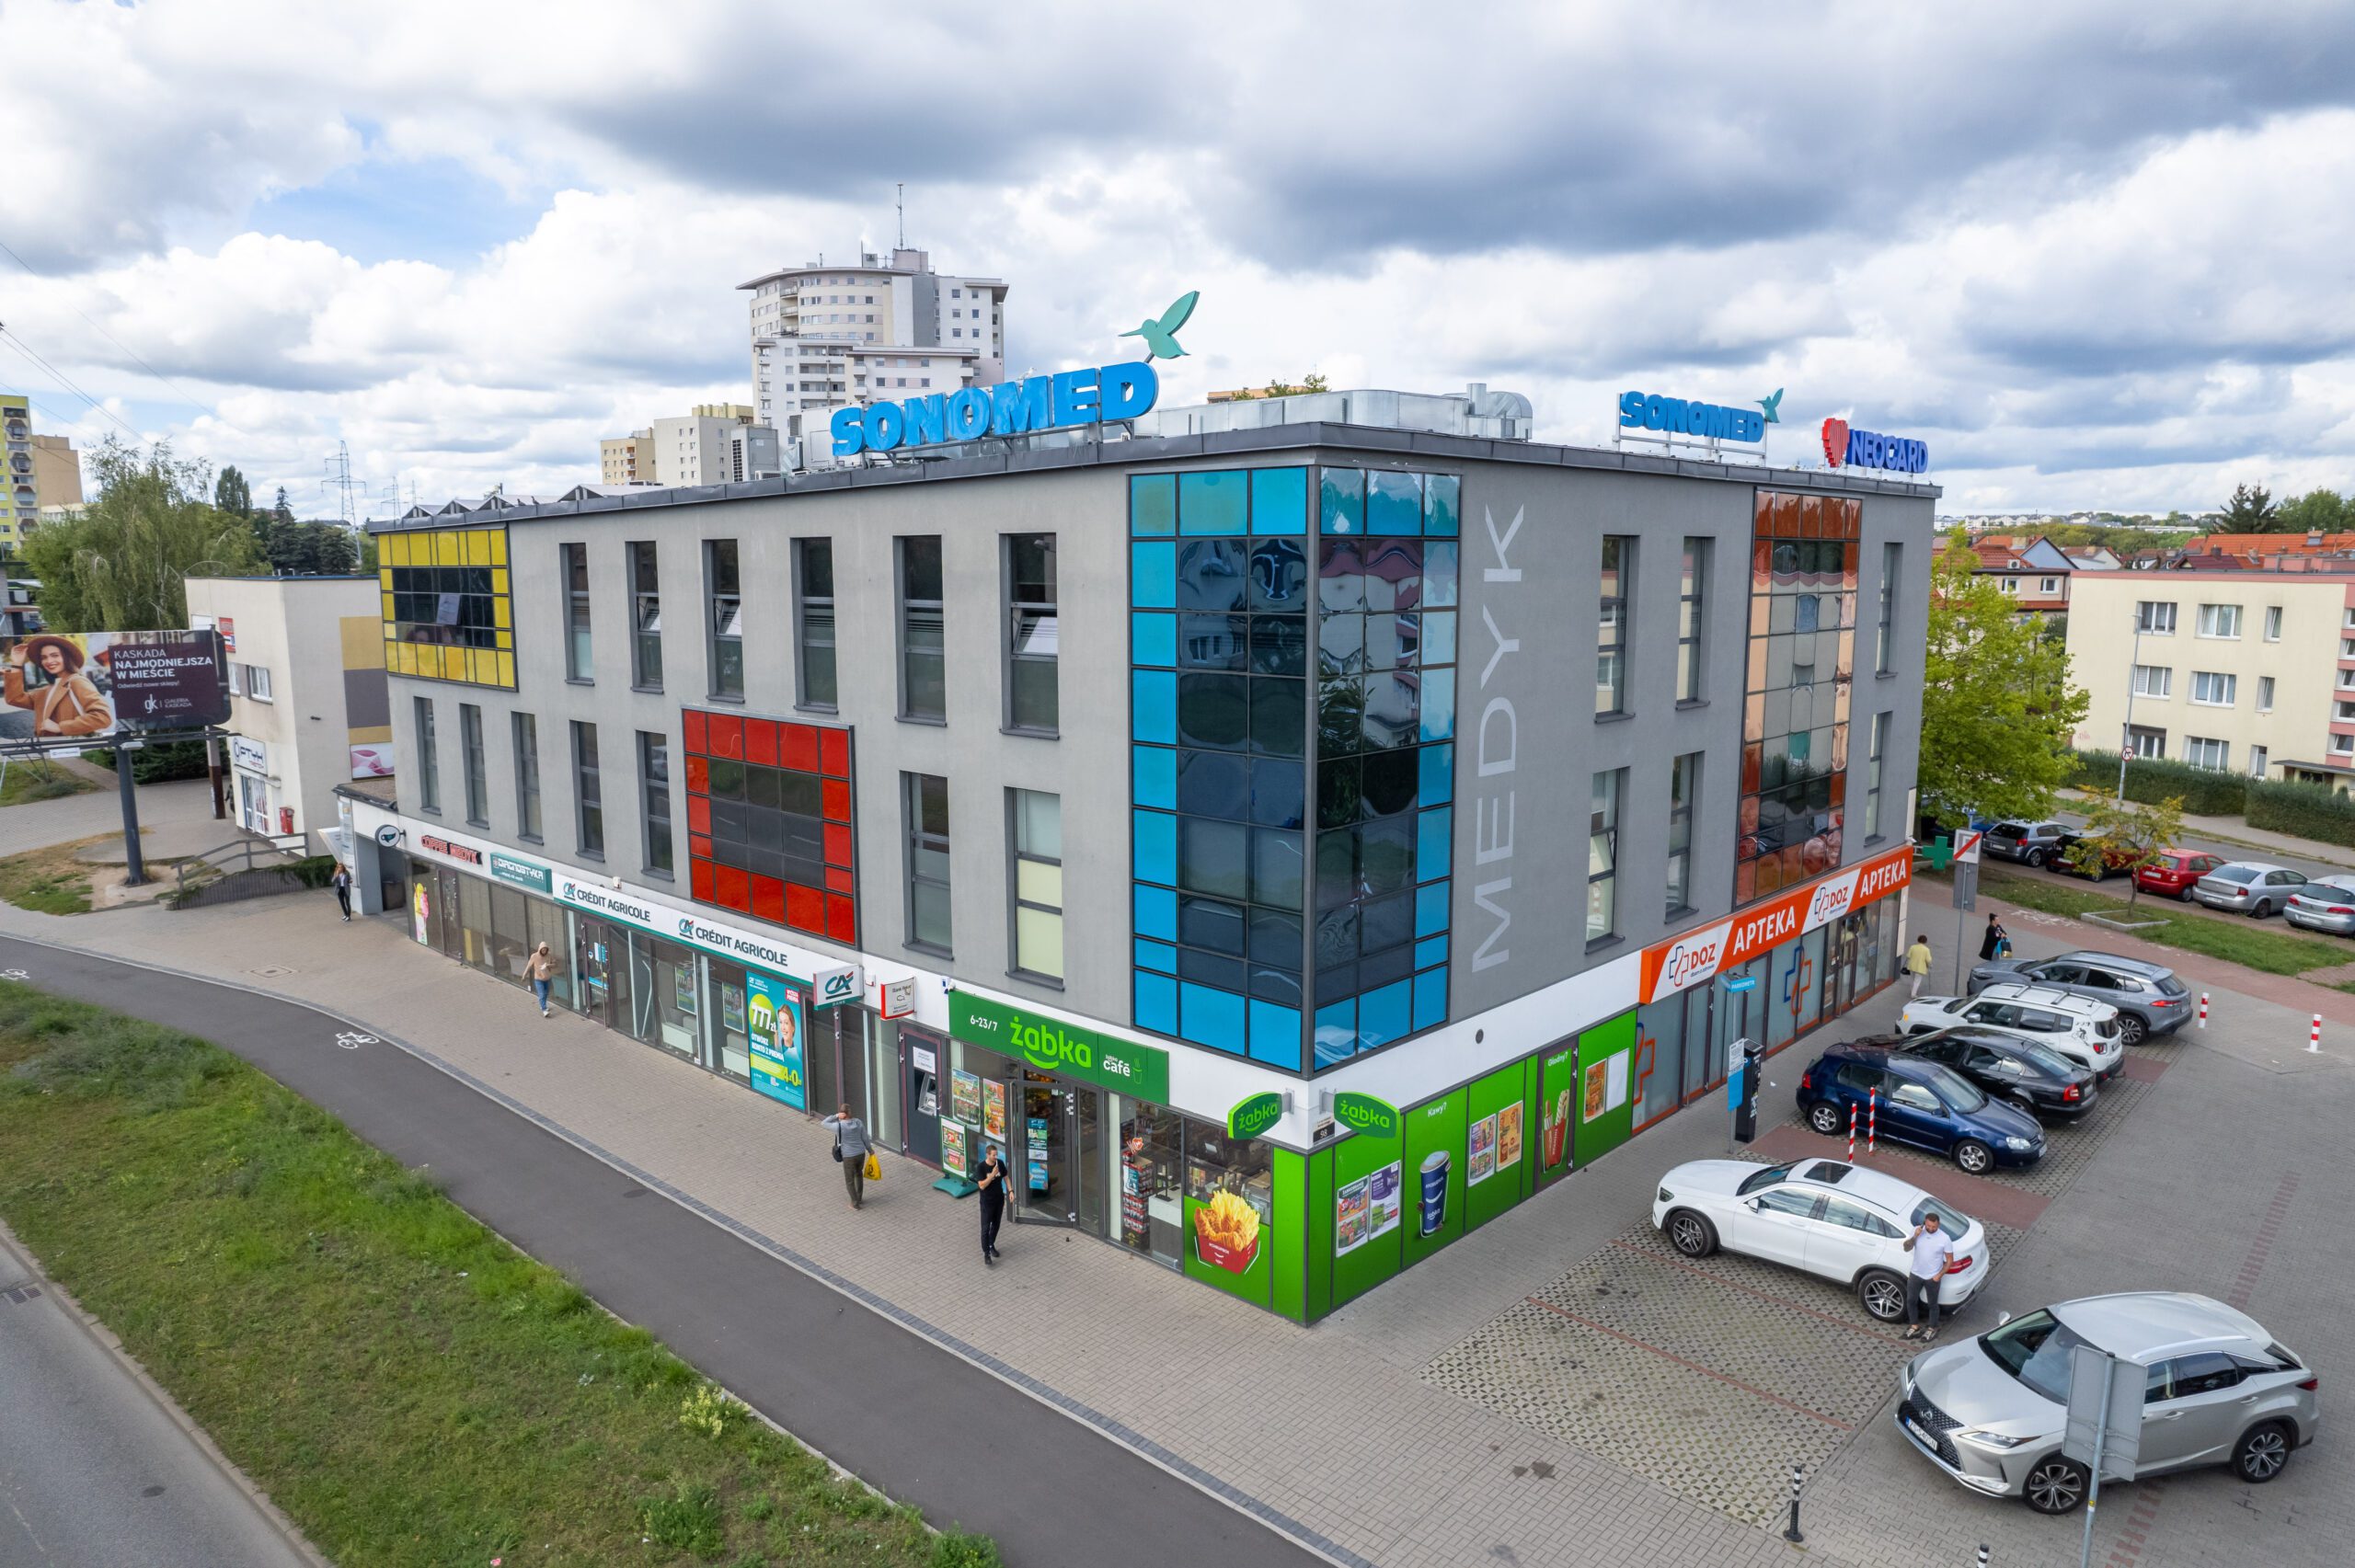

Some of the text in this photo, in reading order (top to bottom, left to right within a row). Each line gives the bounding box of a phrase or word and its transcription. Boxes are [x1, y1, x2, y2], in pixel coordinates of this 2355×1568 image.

[830, 361, 1159, 456] SONOMED
[1620, 391, 1764, 442] SONOMED
[1847, 429, 1928, 474] NEOCARD
[114, 648, 167, 659] KASKADA
[115, 657, 213, 670] NAJMODNIEJSZA
[116, 668, 176, 680] W MIEŚCIE
[1472, 503, 1524, 973] MEDYK
[421, 836, 480, 864] COFFEE MEDYK
[498, 858, 544, 880] DIAGNOSTYKA
[1860, 859, 1906, 898] APTEKA
[577, 889, 606, 908] CRÉDIT
[607, 899, 651, 922] AGRICOLE
[1830, 886, 1848, 908] DOZ
[1733, 906, 1795, 956] APTEKA
[695, 927, 732, 948] CRÉDIT
[734, 939, 788, 967] AGRICOLE
[1691, 943, 1716, 969] DOZ
[752, 1001, 771, 1030] 777
[970, 1015, 1092, 1068] 6-23/7 żabka
[1238, 1103, 1278, 1129] żabka
[1340, 1101, 1390, 1127] żabka
[1428, 1102, 1447, 1117] Kawy?
